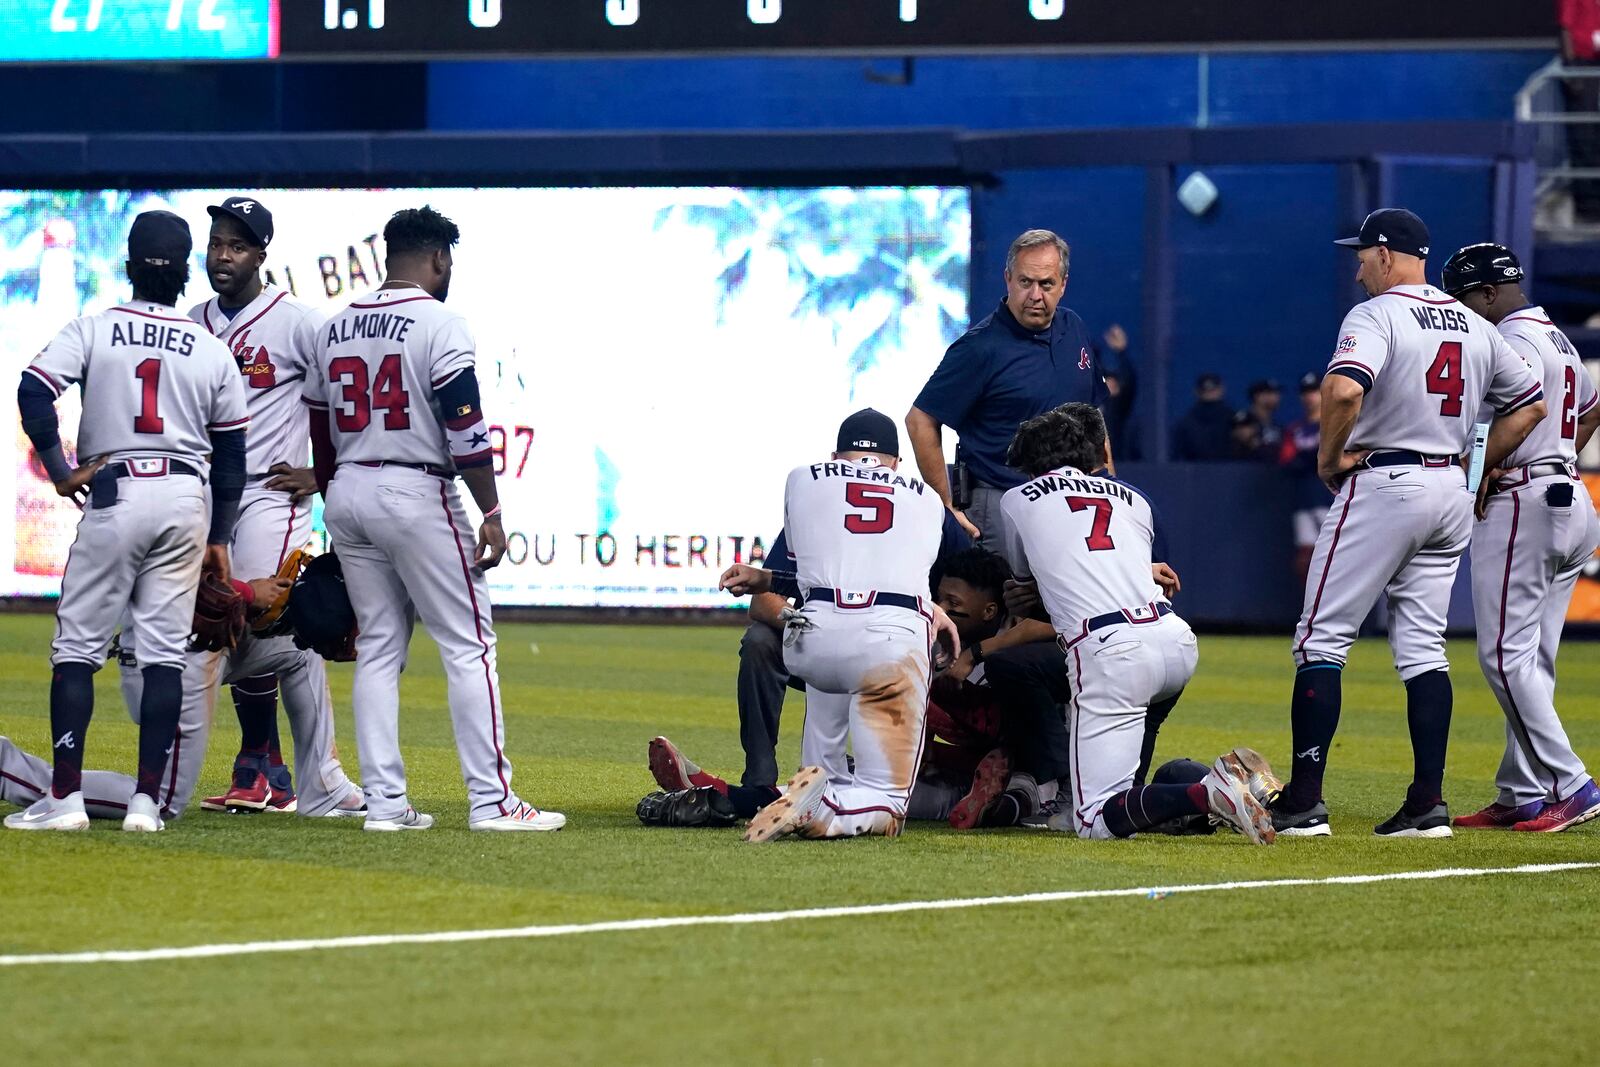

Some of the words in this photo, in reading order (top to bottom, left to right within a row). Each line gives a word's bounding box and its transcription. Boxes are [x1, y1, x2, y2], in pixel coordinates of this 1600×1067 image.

[111, 322, 196, 357] ALBIES
[327, 313, 415, 348] ALMONTE
[1410, 306, 1469, 334] WEISS
[134, 358, 164, 434] 1
[328, 354, 411, 433] 34
[1426, 341, 1465, 417] 4
[1561, 365, 1576, 439] 2
[810, 462, 924, 495] FREEMAN
[1021, 477, 1132, 507] SWANSON
[844, 482, 894, 534] 5
[1065, 496, 1115, 552] 7
[574, 532, 617, 567] TO
[635, 534, 777, 568] HERITA
